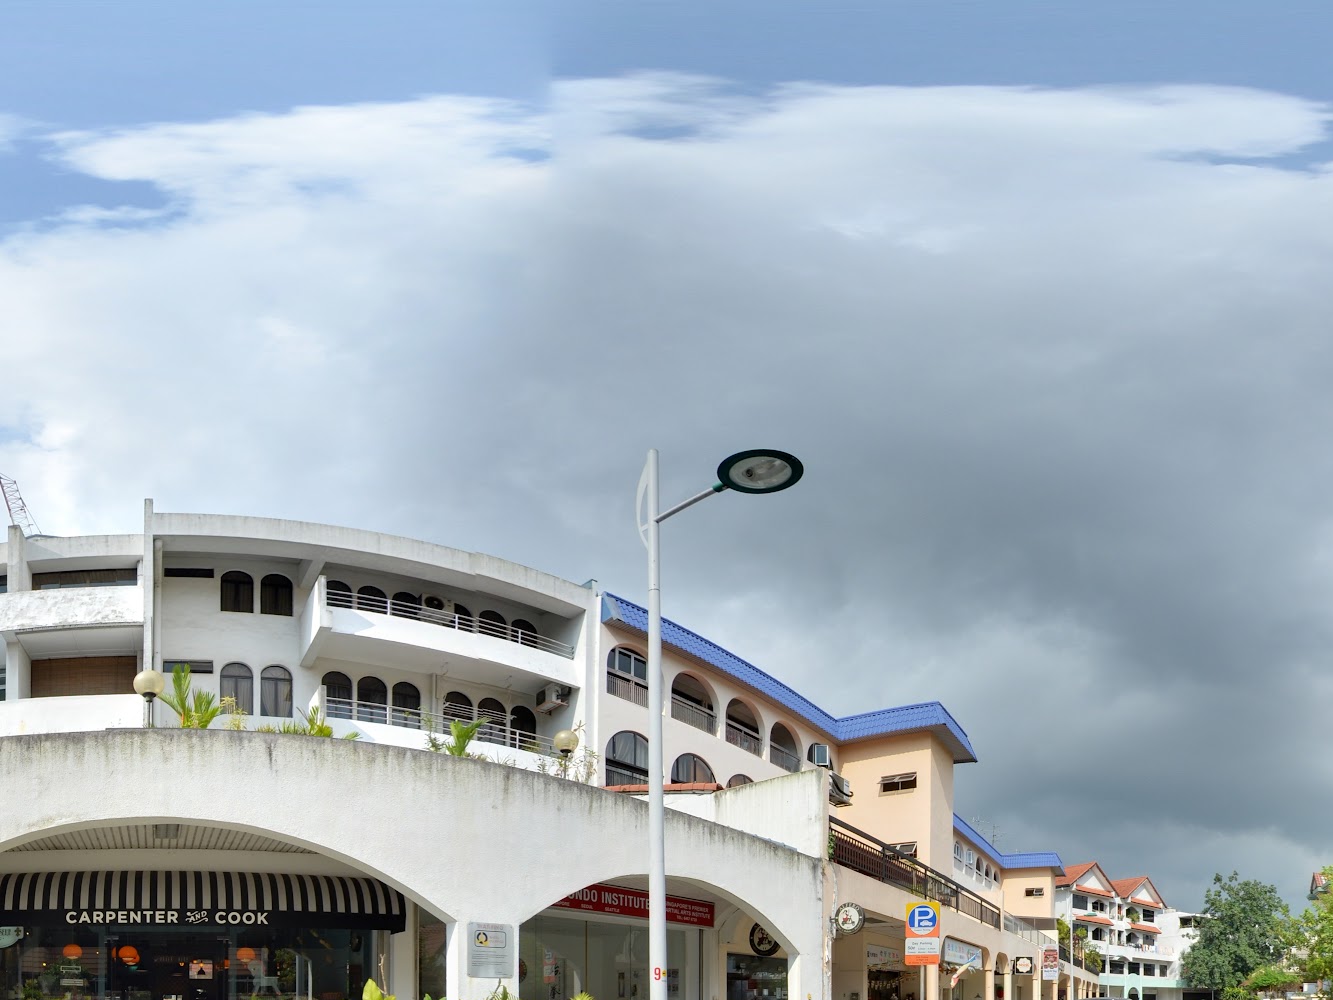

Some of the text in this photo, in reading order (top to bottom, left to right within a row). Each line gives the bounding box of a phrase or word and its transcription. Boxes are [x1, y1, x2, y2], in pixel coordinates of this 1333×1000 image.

[601, 891, 649, 910] INSTITUTE
[666, 902, 691, 911] INGAPORE'S
[65, 910, 269, 925] CARPENTER AND COOK
[666, 907, 680, 915] ARTIAL
[692, 911, 711, 920] INSTITUTE
[914, 907, 934, 928] P
[653, 967, 661, 981] 9
